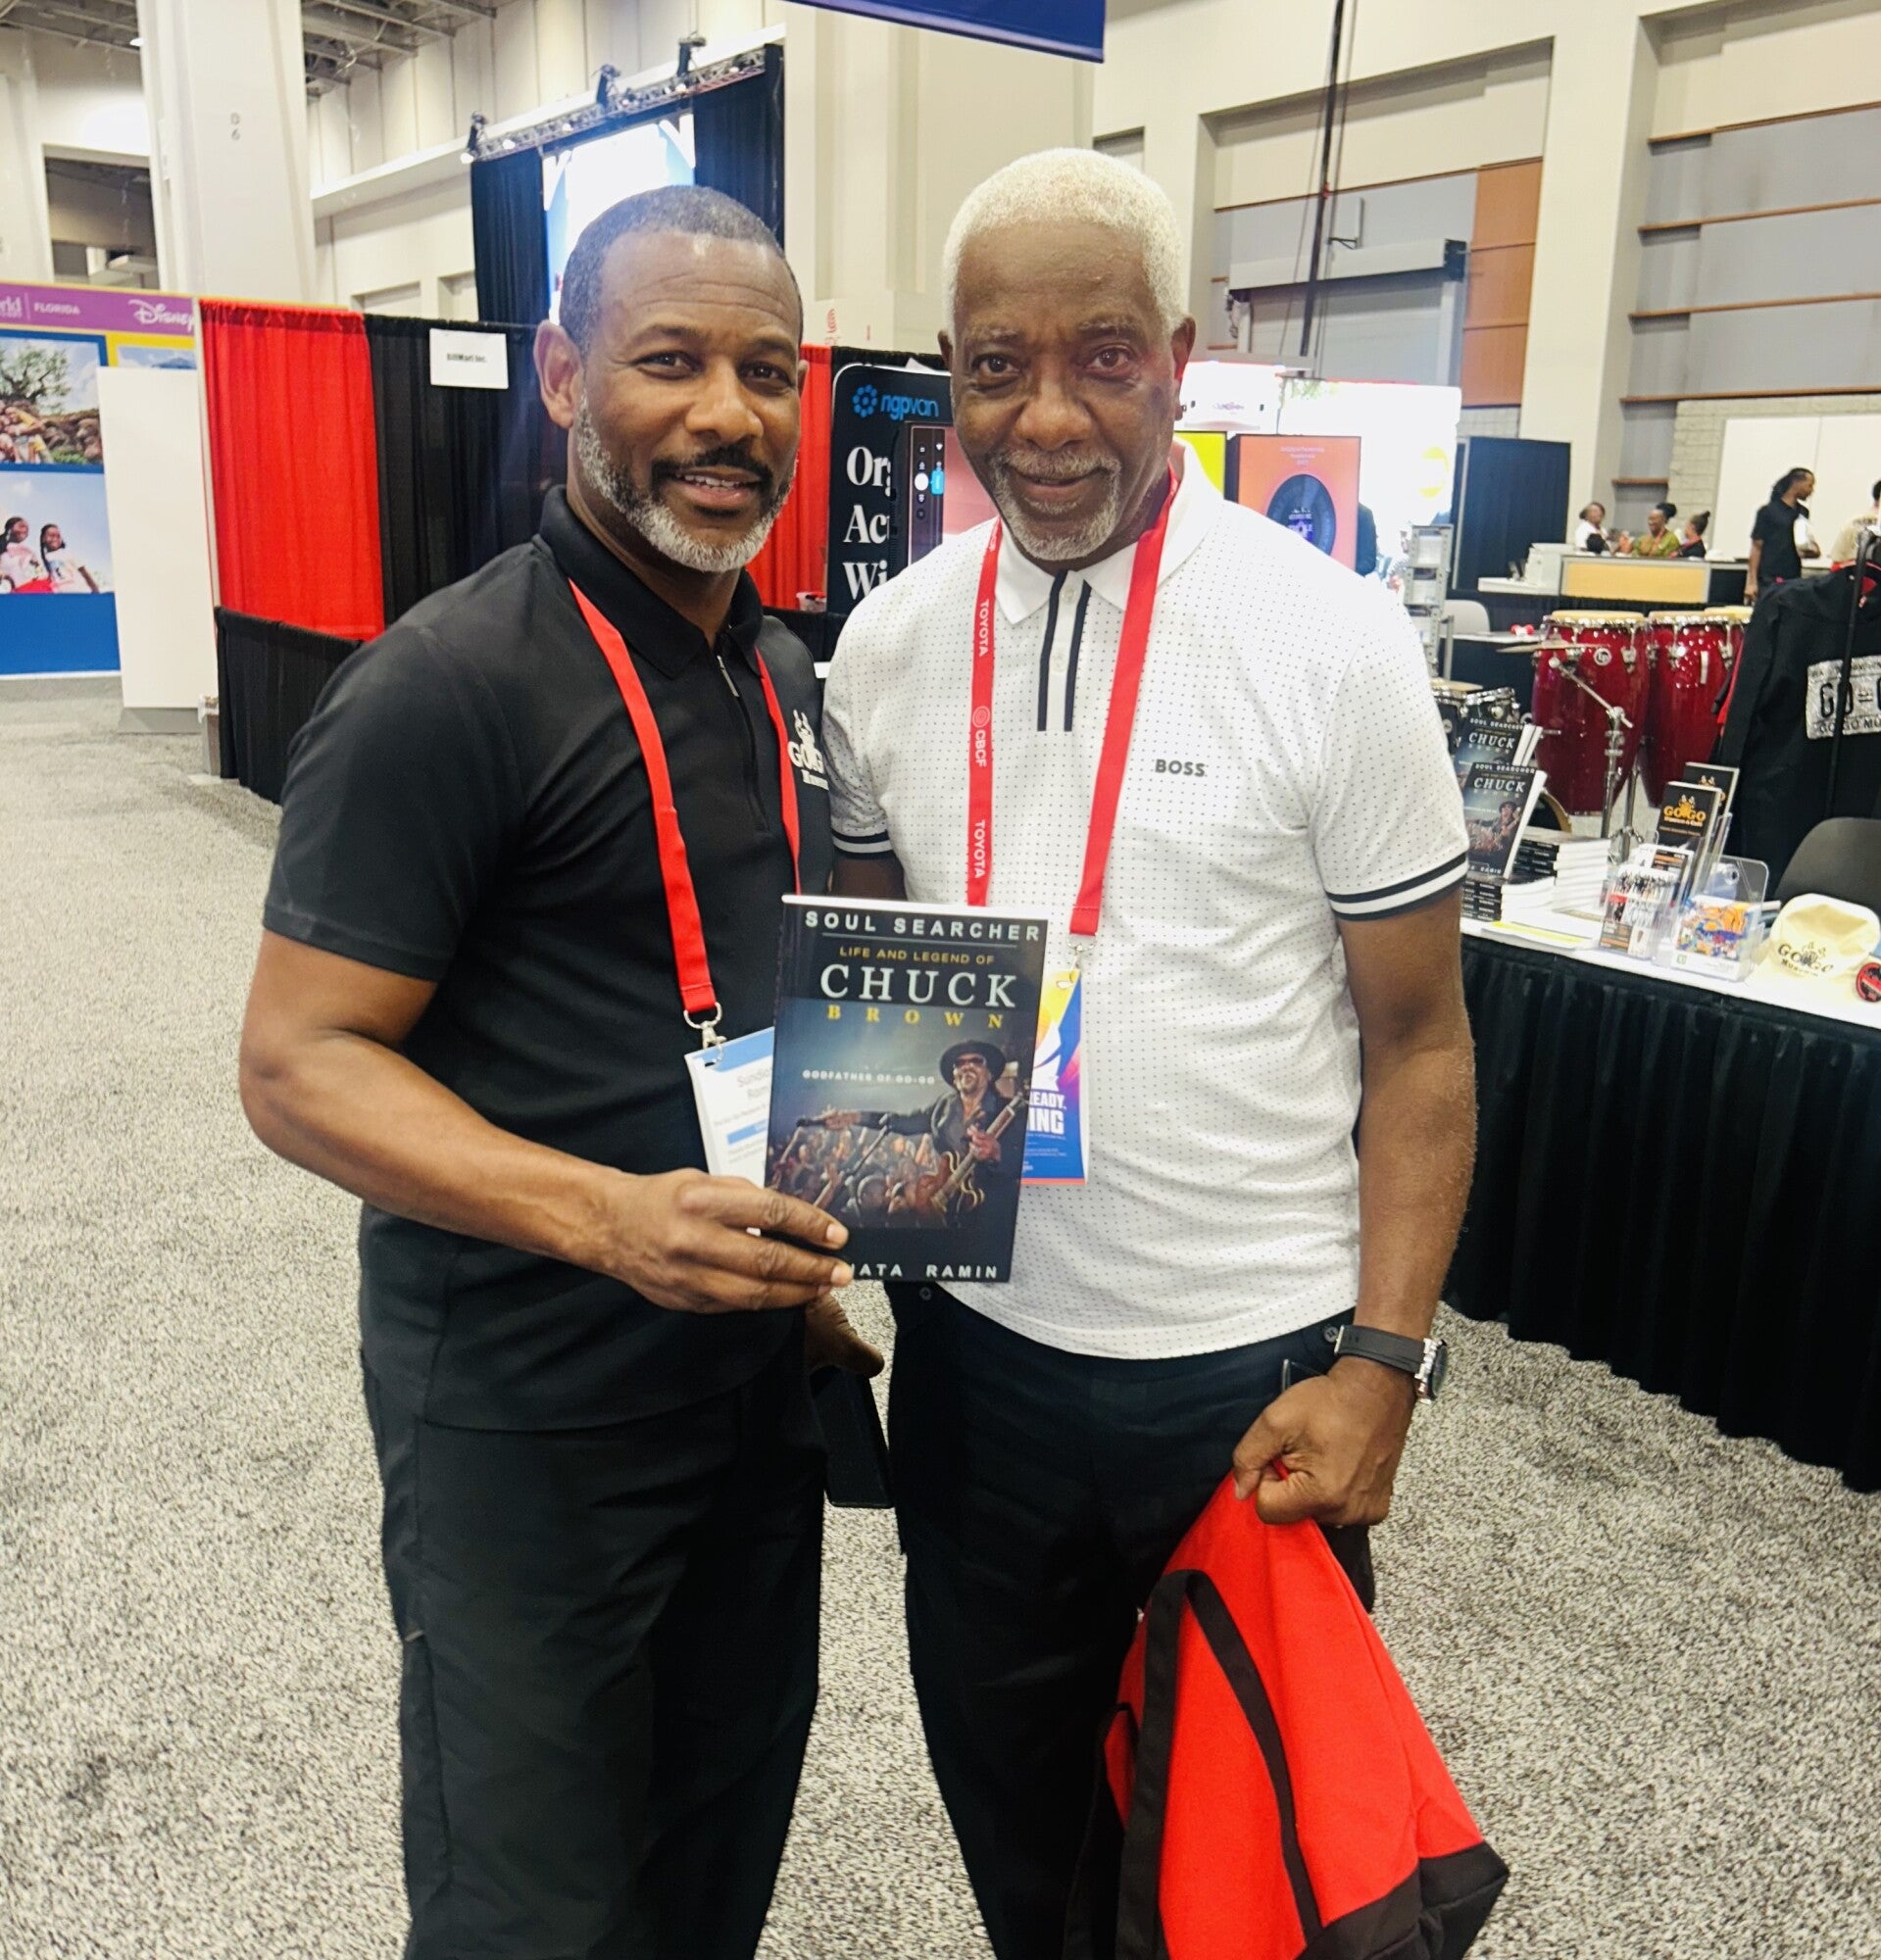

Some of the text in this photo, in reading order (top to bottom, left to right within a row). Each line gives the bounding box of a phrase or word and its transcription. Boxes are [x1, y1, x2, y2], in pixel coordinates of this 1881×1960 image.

[33, 302, 80, 316] FLORIDA
[128, 299, 194, 332] Disney
[881, 394, 939, 420] ngpvan
[978, 599, 990, 658] TOYOTA
[1470, 717, 1487, 726] SOUL
[975, 729, 987, 767] CBCF
[1468, 732, 1515, 750] CHUCK
[1155, 759, 1206, 777] BOSS
[1473, 777, 1526, 794] CHUCK
[974, 819, 986, 878] TOYOTA
[806, 909, 1040, 942] SOUL SEARCHER
[839, 946, 995, 965] LIFE AND LEGEND OF
[819, 962, 1017, 1009] CHUCK
[826, 1004, 1004, 1029] BROWN
[802, 1068, 872, 1082] GODFATHER
[876, 1073, 891, 1083] OF
[925, 1263, 998, 1280] RAMIN
